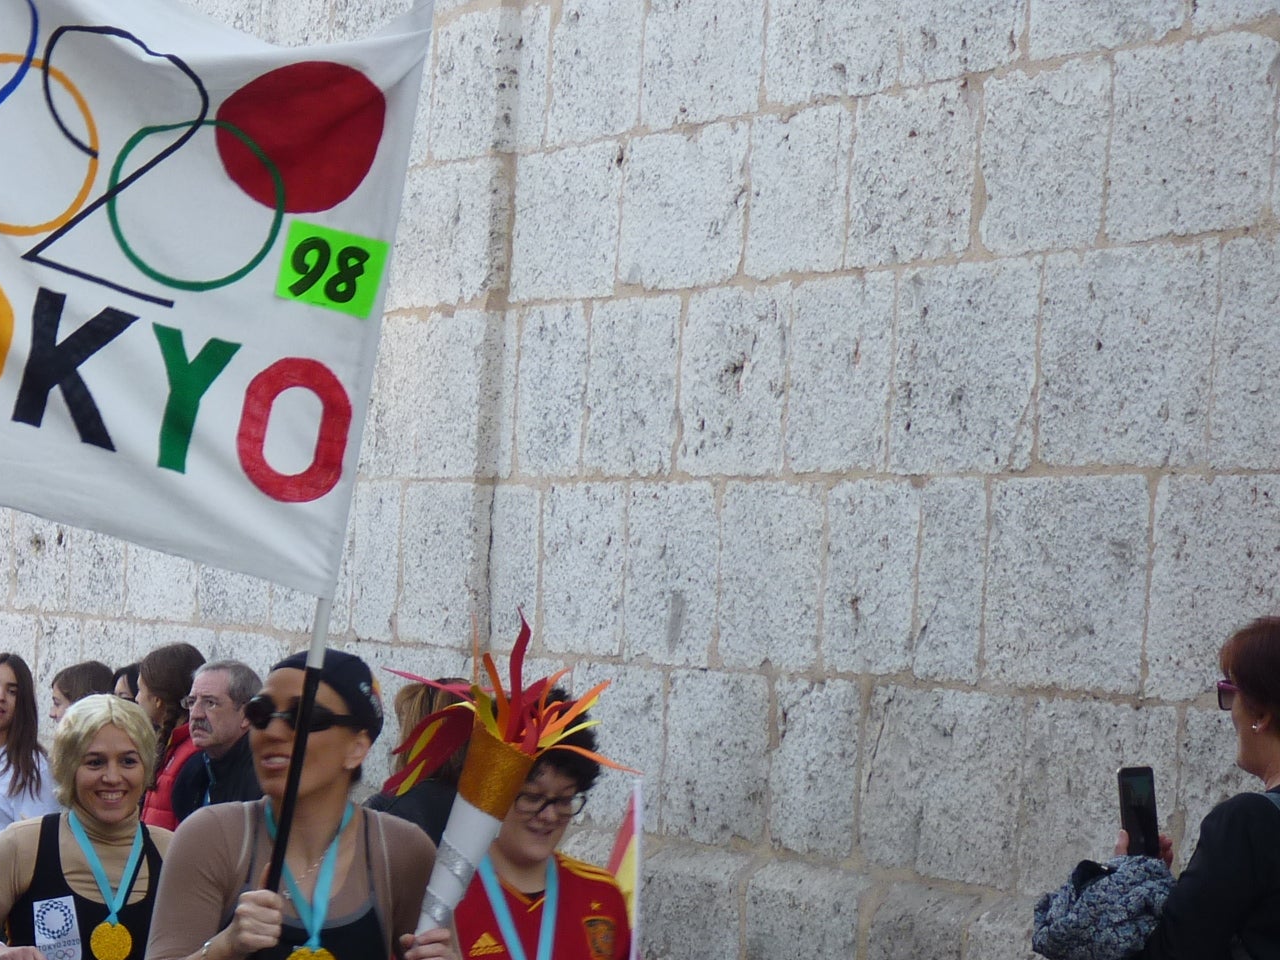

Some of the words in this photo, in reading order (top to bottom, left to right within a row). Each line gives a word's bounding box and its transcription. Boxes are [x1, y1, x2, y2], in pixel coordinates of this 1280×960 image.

[287, 236, 371, 304] 98
[38, 942, 62, 951] TOKYO
[63, 939, 80, 947] 2020
